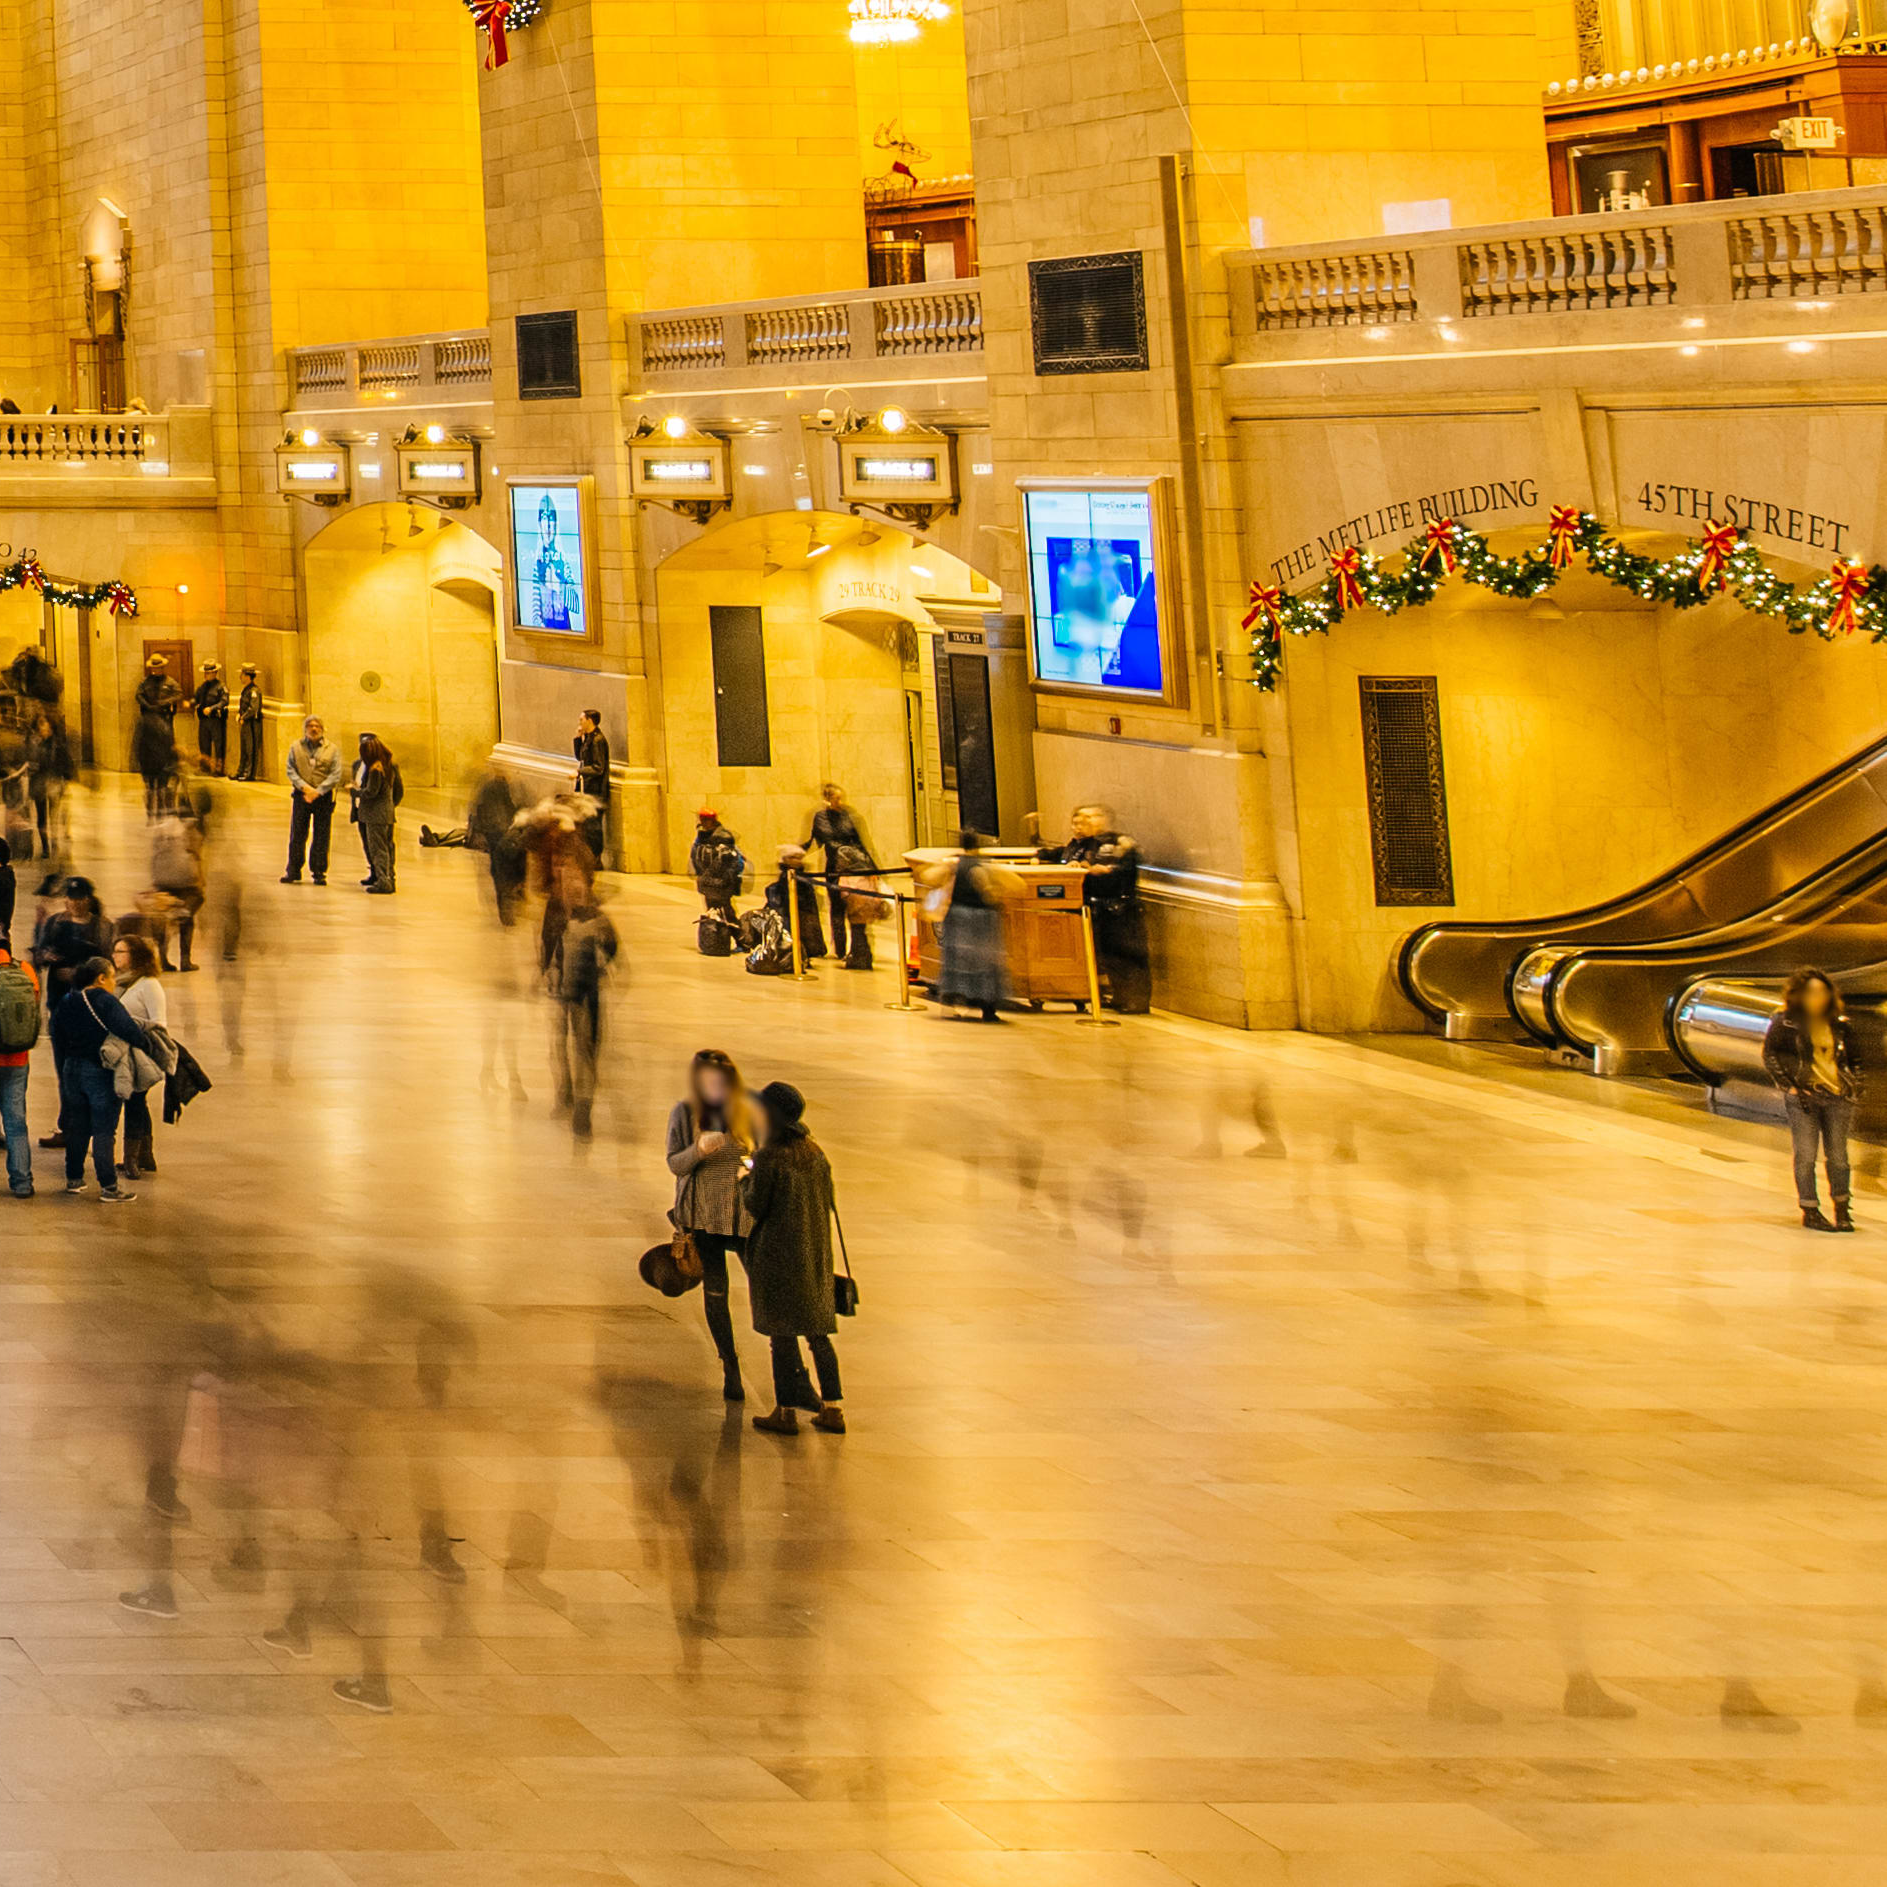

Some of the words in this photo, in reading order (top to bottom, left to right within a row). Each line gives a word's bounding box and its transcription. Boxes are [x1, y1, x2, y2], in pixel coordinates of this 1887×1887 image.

[1802, 120, 1828, 138] EXIT
[1637, 482, 1714, 521] 45TH
[1724, 494, 1850, 555] STREET
[1270, 542, 1317, 586] THE
[1316, 501, 1414, 557] METLIFE
[1417, 478, 1539, 525] BUILDING
[17, 546, 38, 562] 42
[839, 583, 849, 599] 29
[851, 581, 887, 599] TRACK
[889, 586, 900, 603] 29
[953, 632, 971, 642] TRACK
